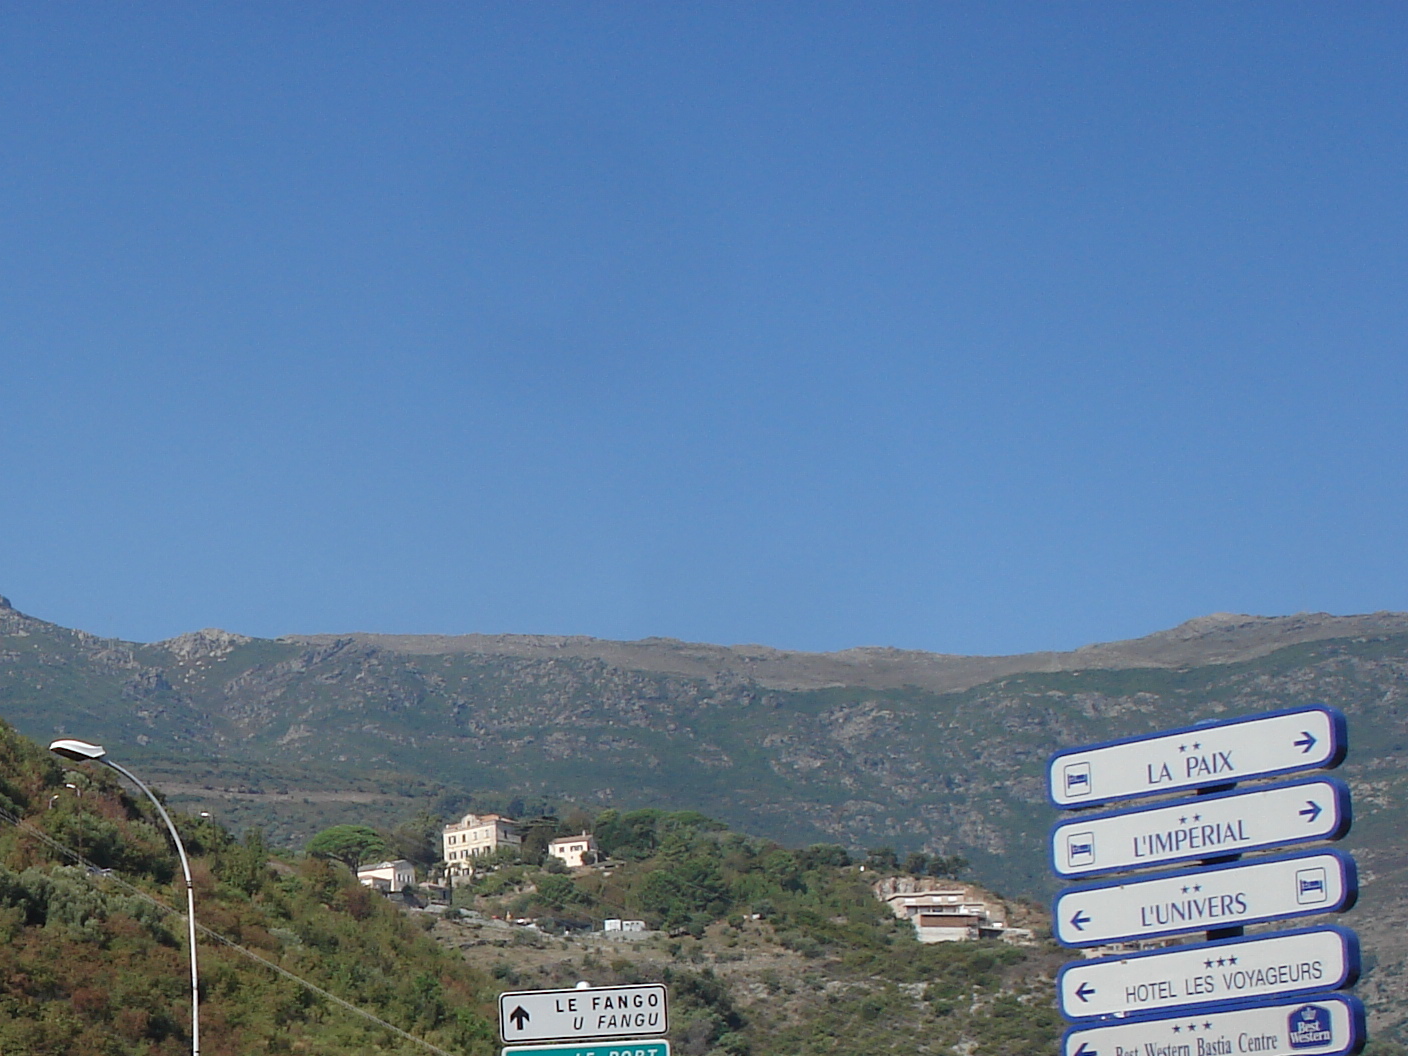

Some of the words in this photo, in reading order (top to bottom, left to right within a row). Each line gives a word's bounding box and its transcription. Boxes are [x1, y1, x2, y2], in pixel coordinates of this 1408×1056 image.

[1147, 762, 1172, 784] LA
[1186, 751, 1235, 778] PAIX
[1133, 819, 1251, 858] L'IMPERIAL
[1141, 892, 1248, 927] L'UNIVERS
[1125, 979, 1177, 1004] HOTEL
[1185, 975, 1215, 996] LES
[1222, 961, 1323, 991] VOYAGEURS
[556, 998, 577, 1013] LE
[592, 993, 659, 1011] FANGO
[573, 1017, 584, 1030] U
[597, 1012, 659, 1029] FANGU
[1297, 1020, 1321, 1034] Best
[1196, 1034, 1233, 1056] Bastia
[1238, 1031, 1278, 1052] Centre
[1290, 1030, 1331, 1044] Western
